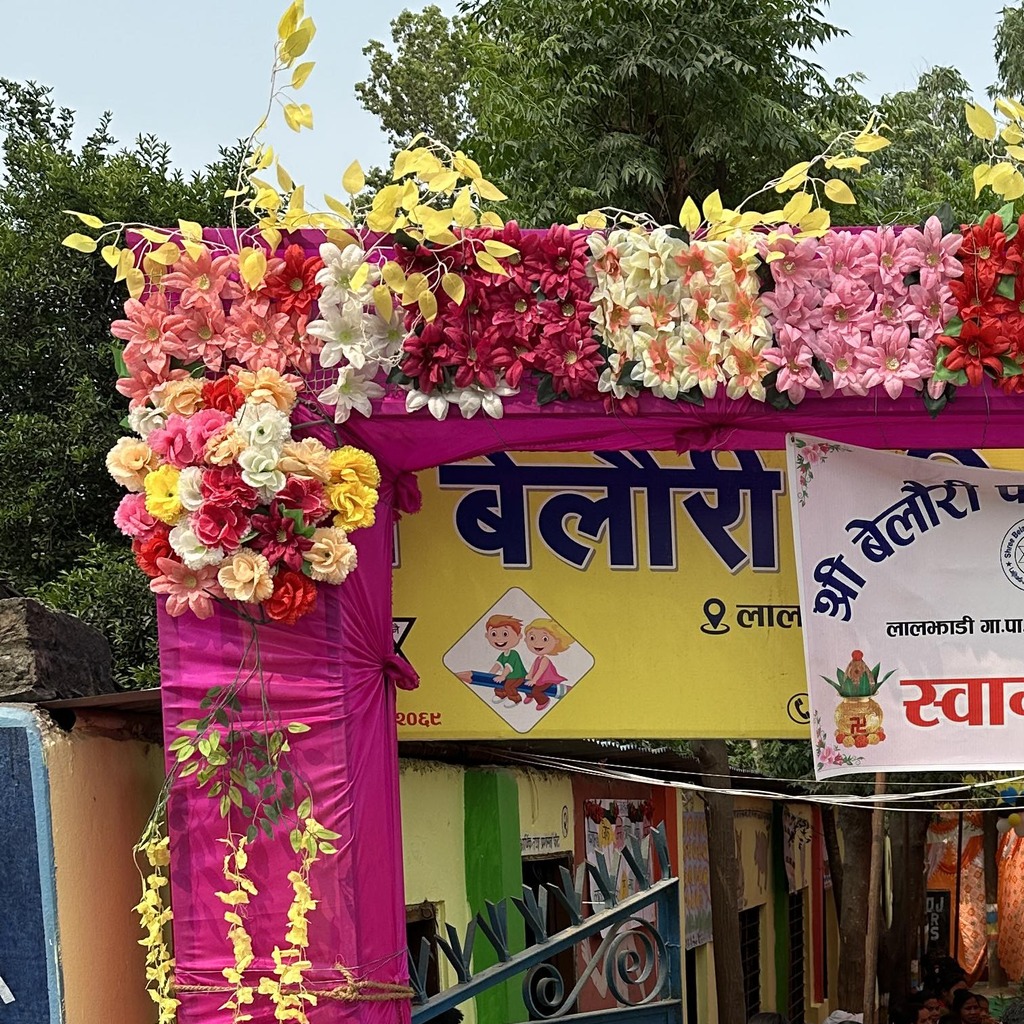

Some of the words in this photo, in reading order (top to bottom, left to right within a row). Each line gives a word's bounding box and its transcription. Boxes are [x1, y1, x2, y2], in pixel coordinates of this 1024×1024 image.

[813, 554, 867, 622] श्री
[845, 479, 981, 563] बेलौरी
[886, 615, 975, 637] लालझाडी
